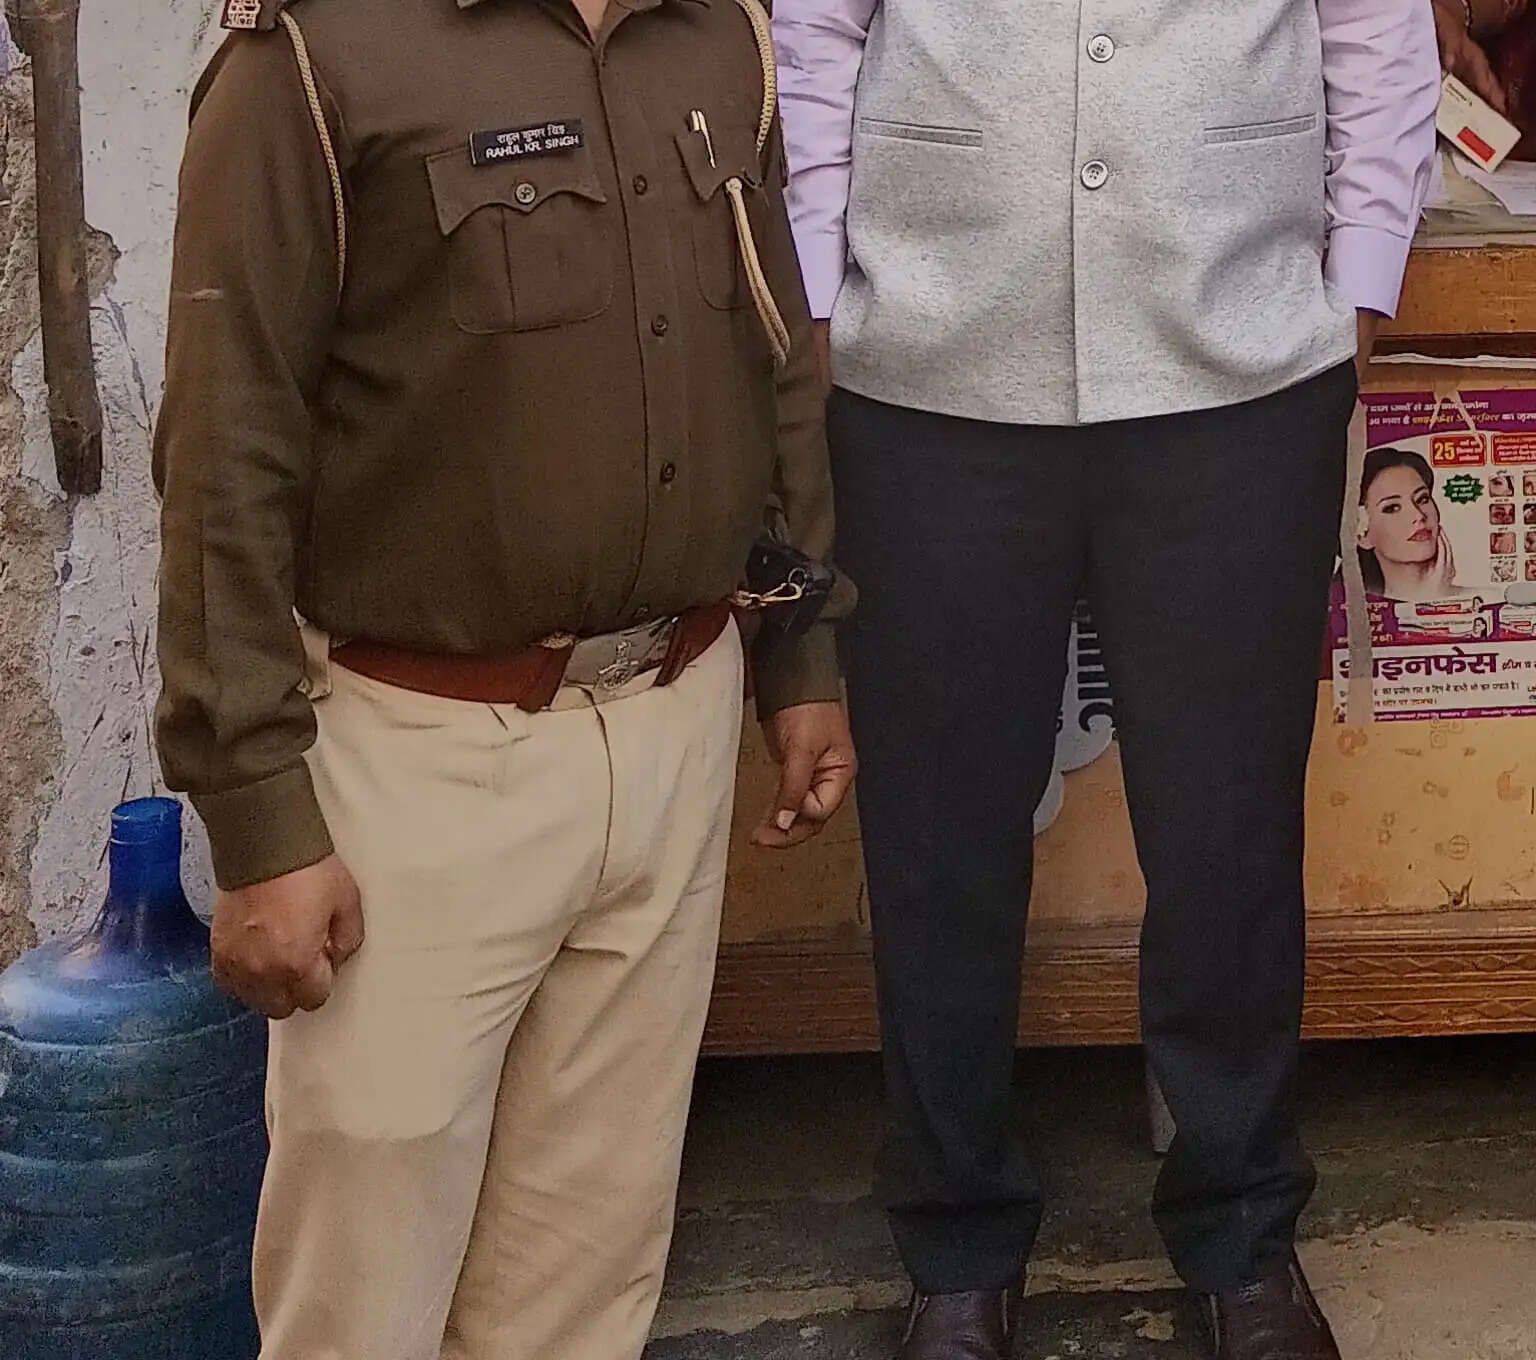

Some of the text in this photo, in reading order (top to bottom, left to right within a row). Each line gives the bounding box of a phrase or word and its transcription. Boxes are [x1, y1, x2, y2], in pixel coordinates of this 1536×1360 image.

[486, 145, 524, 159] RAHUL
[544, 135, 580, 150] SINGH
[1434, 441, 1456, 461] 25
